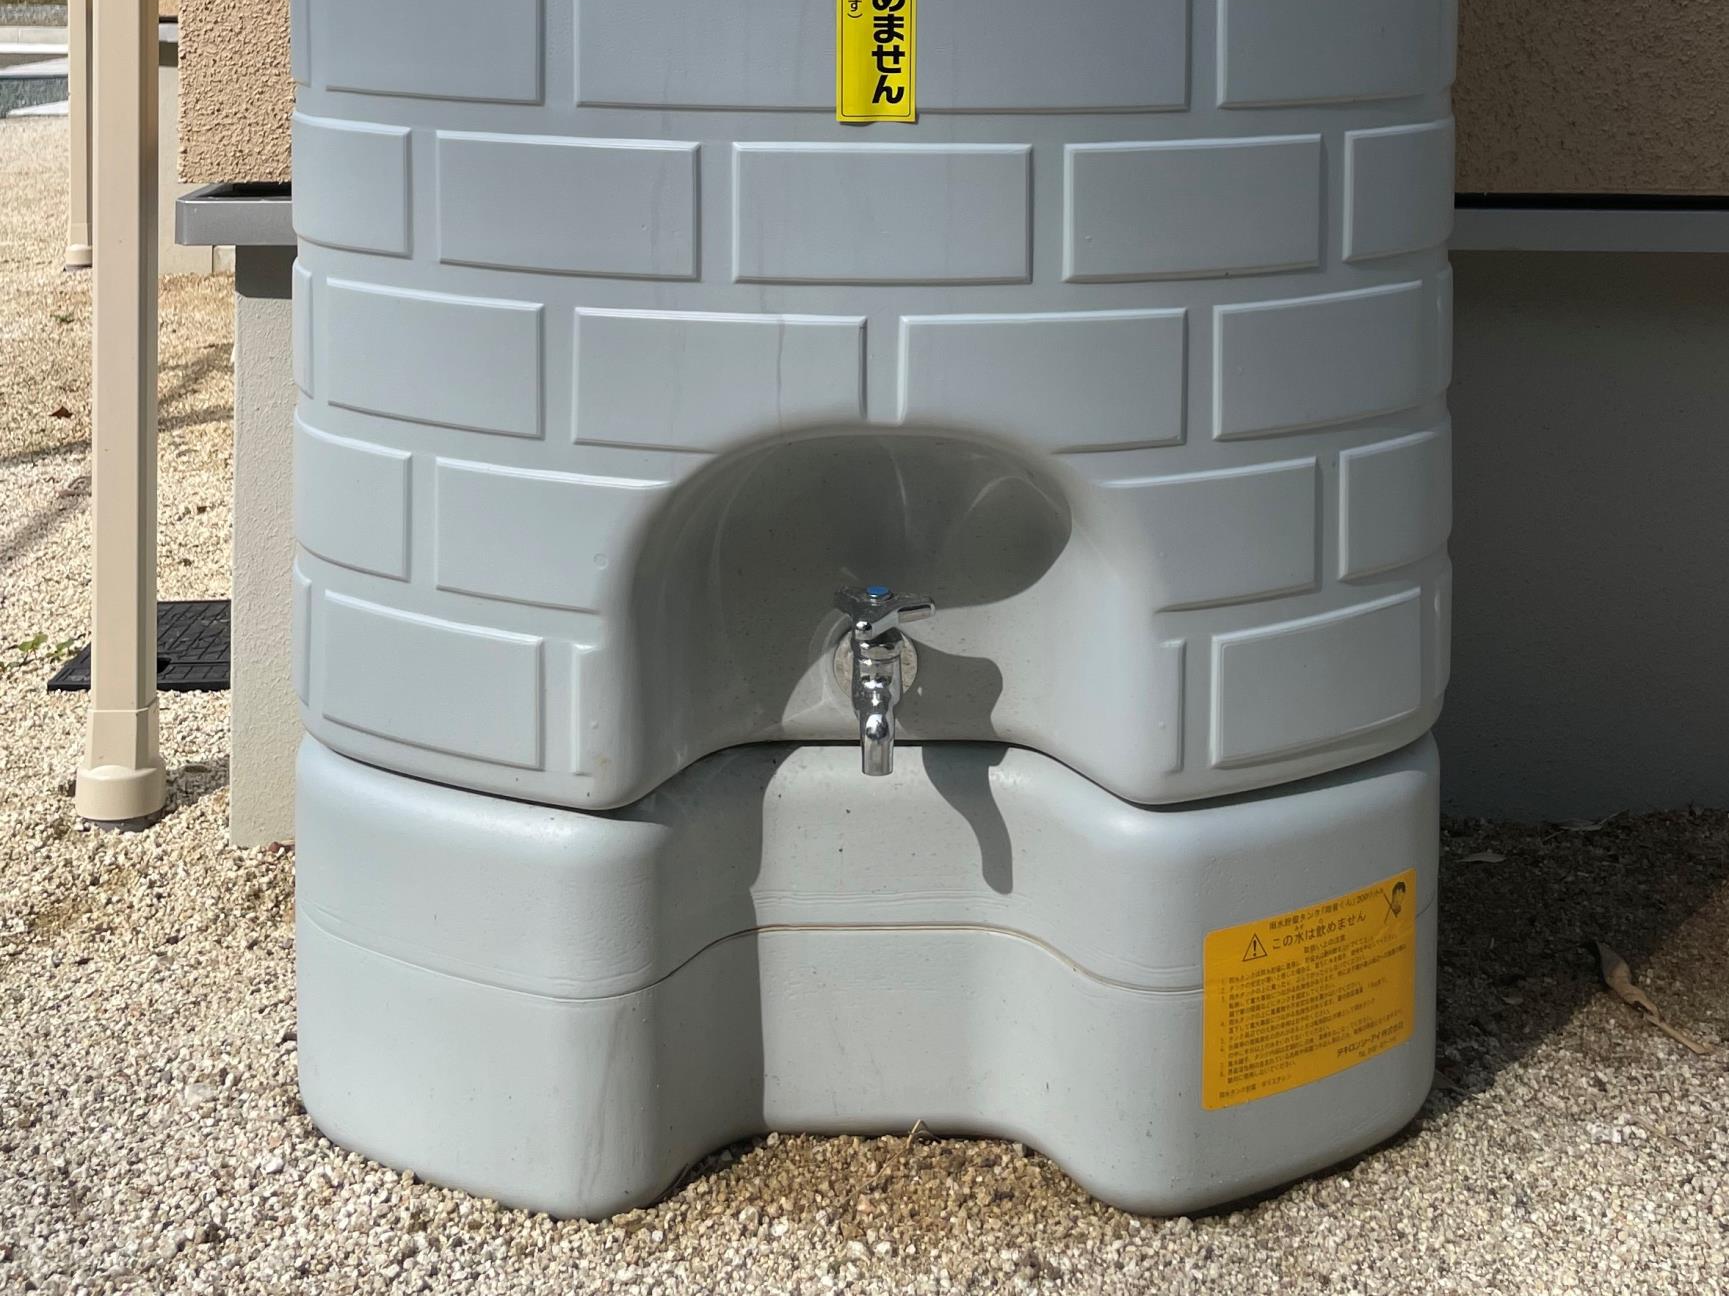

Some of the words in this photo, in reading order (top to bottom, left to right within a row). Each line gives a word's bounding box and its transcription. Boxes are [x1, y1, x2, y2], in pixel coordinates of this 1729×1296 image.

[1272, 911, 1367, 950] この水は飲めません
